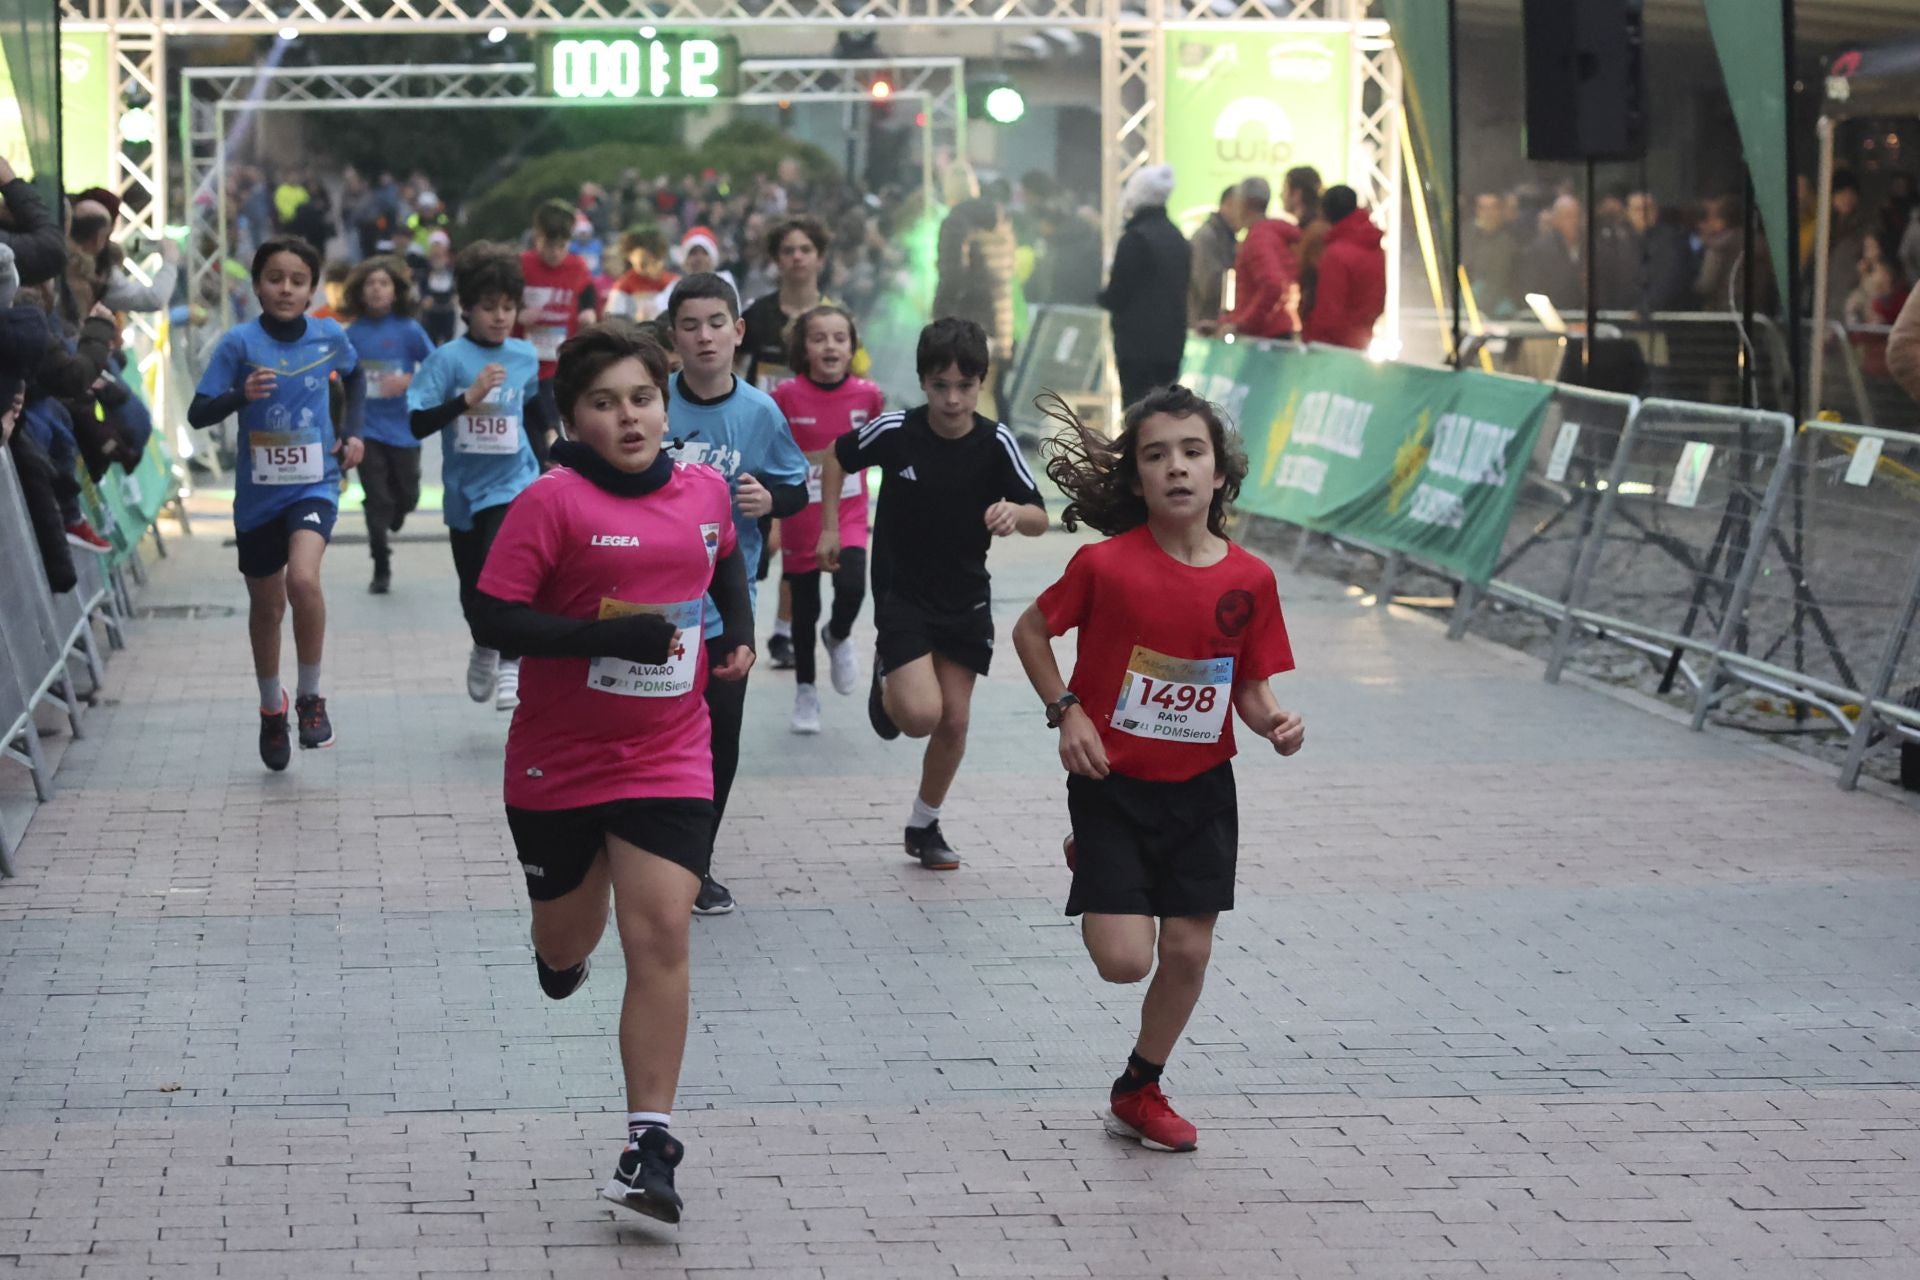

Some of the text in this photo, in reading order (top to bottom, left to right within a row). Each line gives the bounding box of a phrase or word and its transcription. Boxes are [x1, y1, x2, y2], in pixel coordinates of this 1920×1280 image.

[466, 416, 507, 435] 1518
[265, 446, 307, 465] 1551
[591, 534, 640, 547] LEGEA
[628, 665, 675, 676] ALVARO
[633, 679, 688, 692] PDMSiero
[1140, 677, 1217, 713] 1498
[1157, 711, 1188, 723] RAYO
[1153, 724, 1211, 739] PDMSiero
